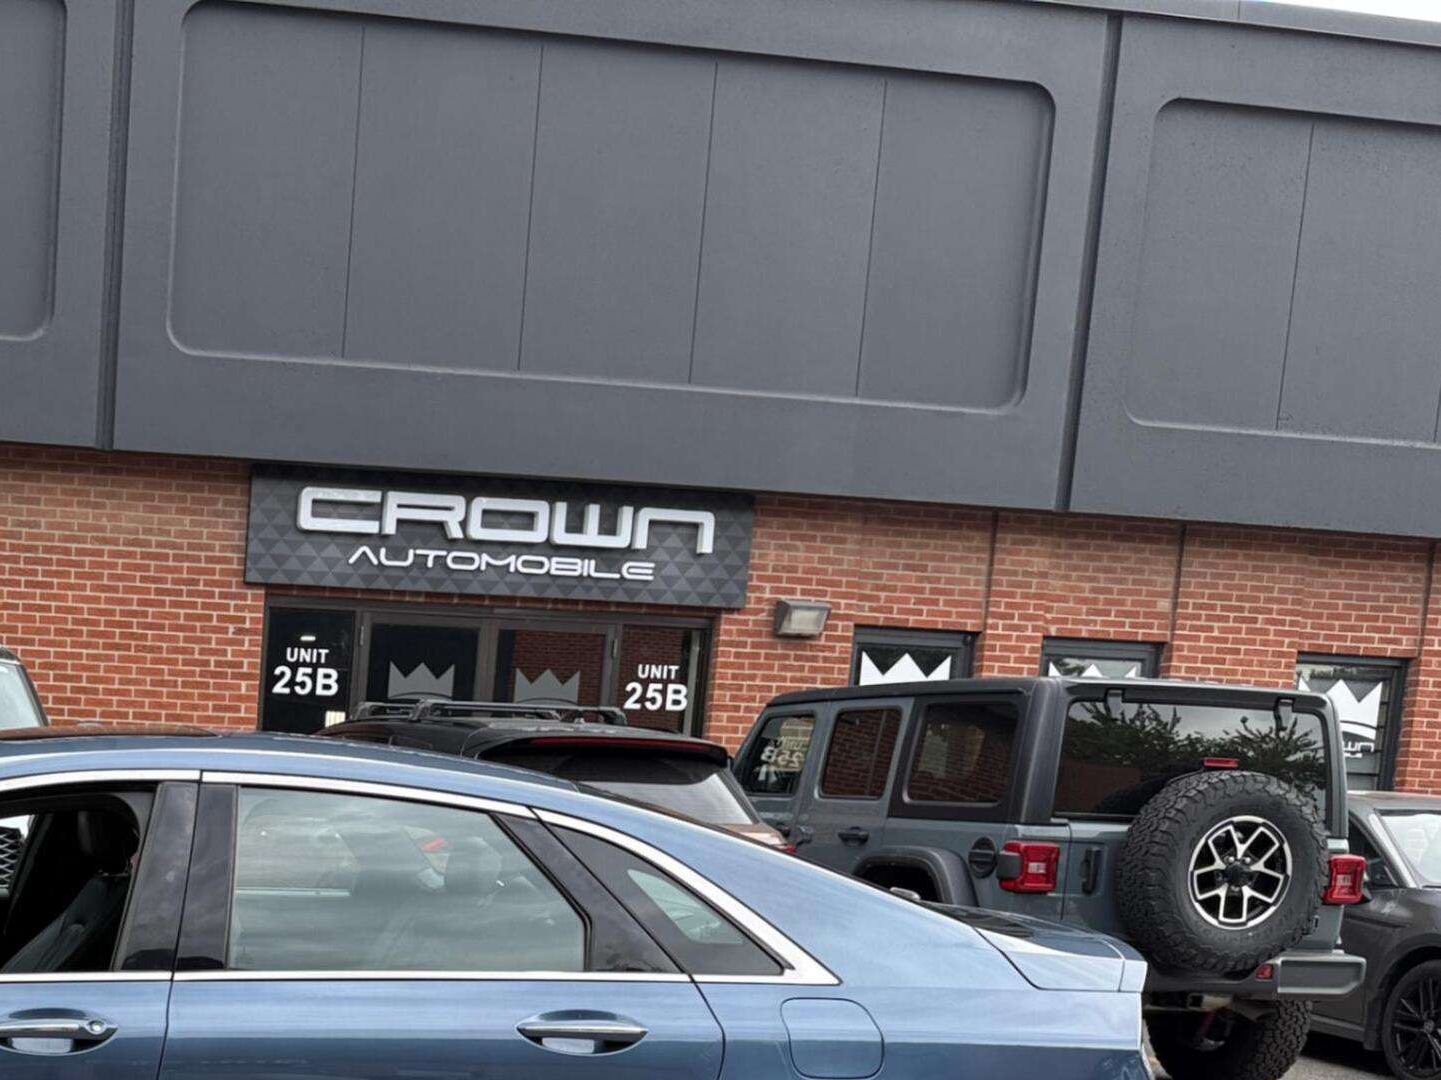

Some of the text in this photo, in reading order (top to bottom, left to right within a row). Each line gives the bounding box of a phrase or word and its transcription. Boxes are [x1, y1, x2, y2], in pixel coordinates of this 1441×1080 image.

[297, 486, 716, 555] CROWN
[348, 545, 656, 581] AUTOMOBILE
[286, 647, 330, 664] UNIT
[271, 665, 339, 697] 25B
[637, 664, 680, 680] UNIT
[623, 681, 688, 712] 25B
